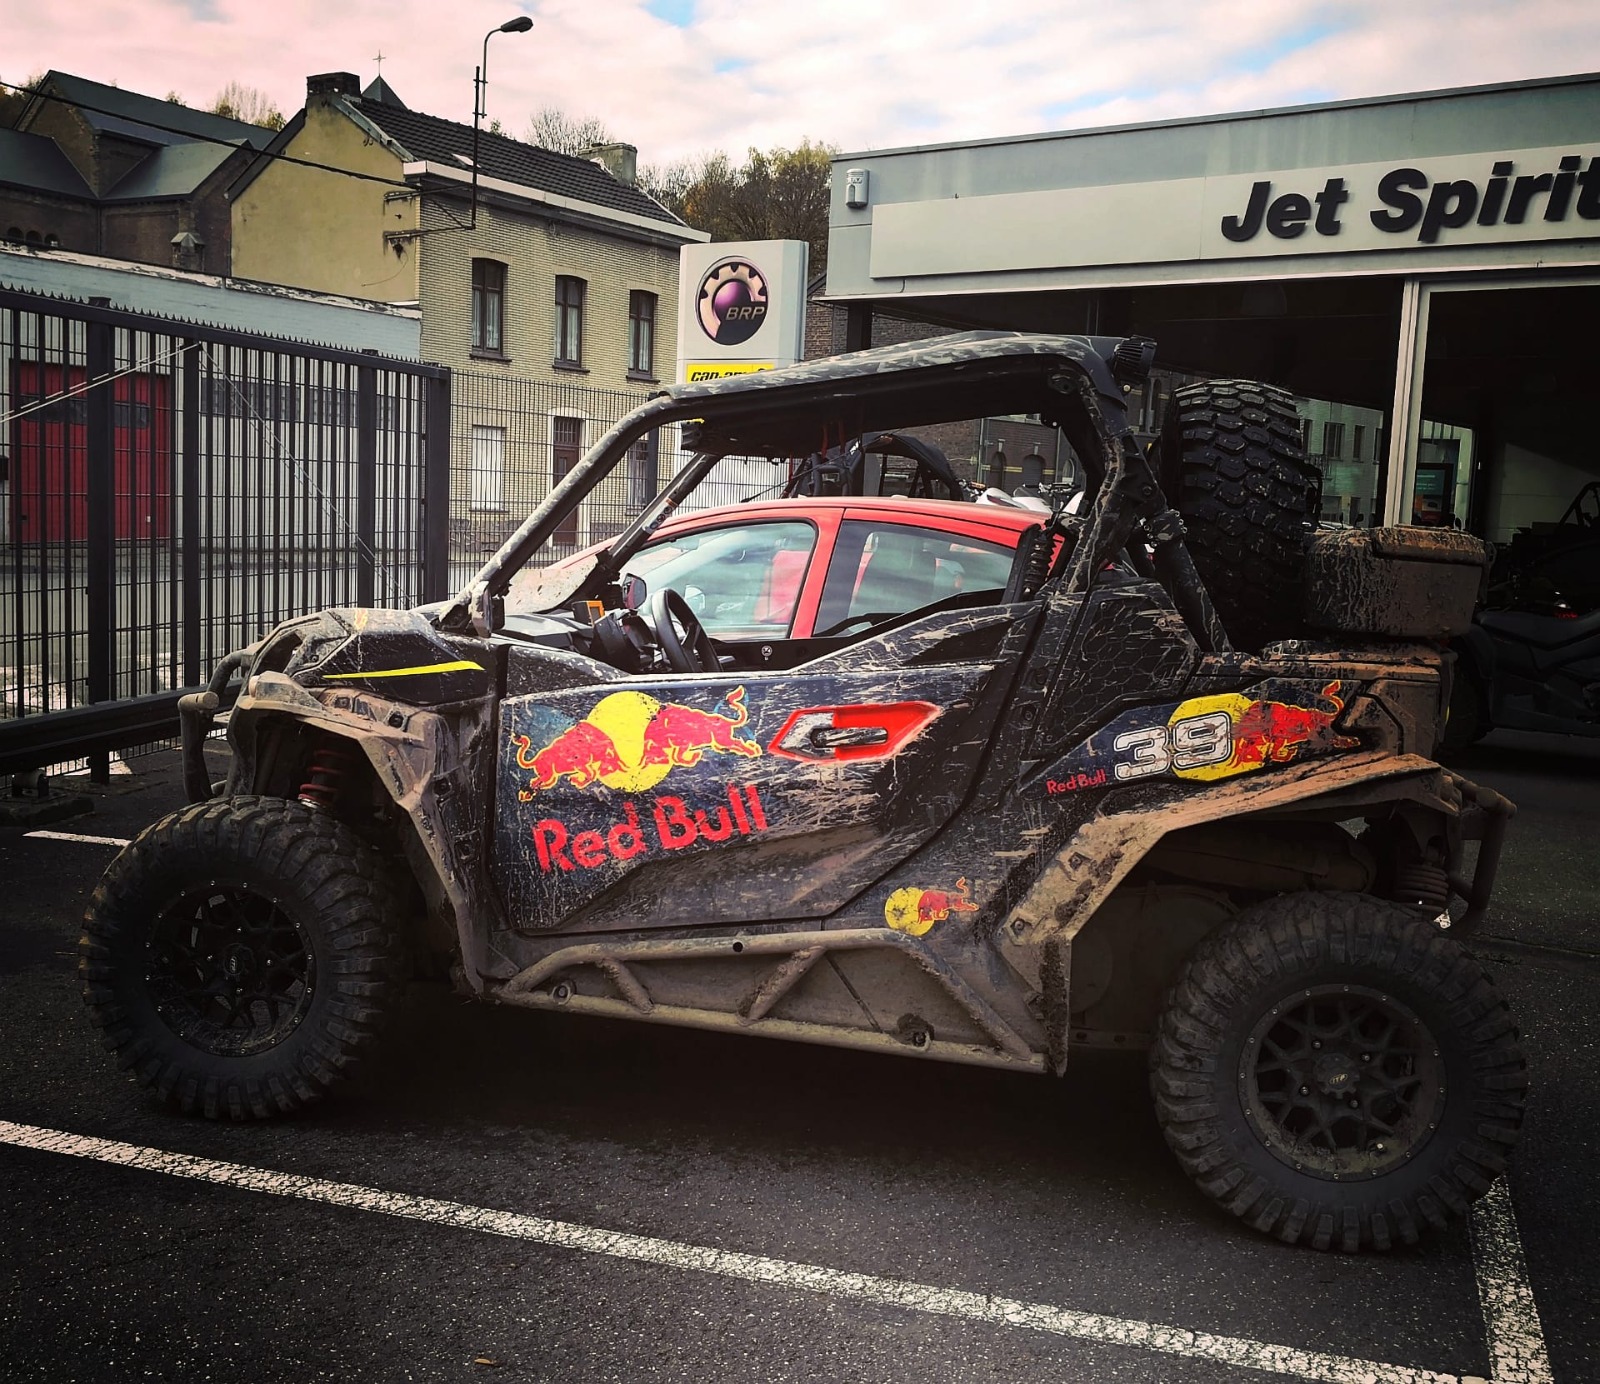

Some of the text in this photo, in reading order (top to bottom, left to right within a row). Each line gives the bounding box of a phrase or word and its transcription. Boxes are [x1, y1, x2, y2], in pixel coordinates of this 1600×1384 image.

[1221, 155, 1600, 243] Jet Spirit
[726, 306, 765, 320] BRP
[1046, 768, 1106, 795] Red Bull
[1113, 710, 1234, 782] 39
[532, 783, 768, 874] Red Bull
